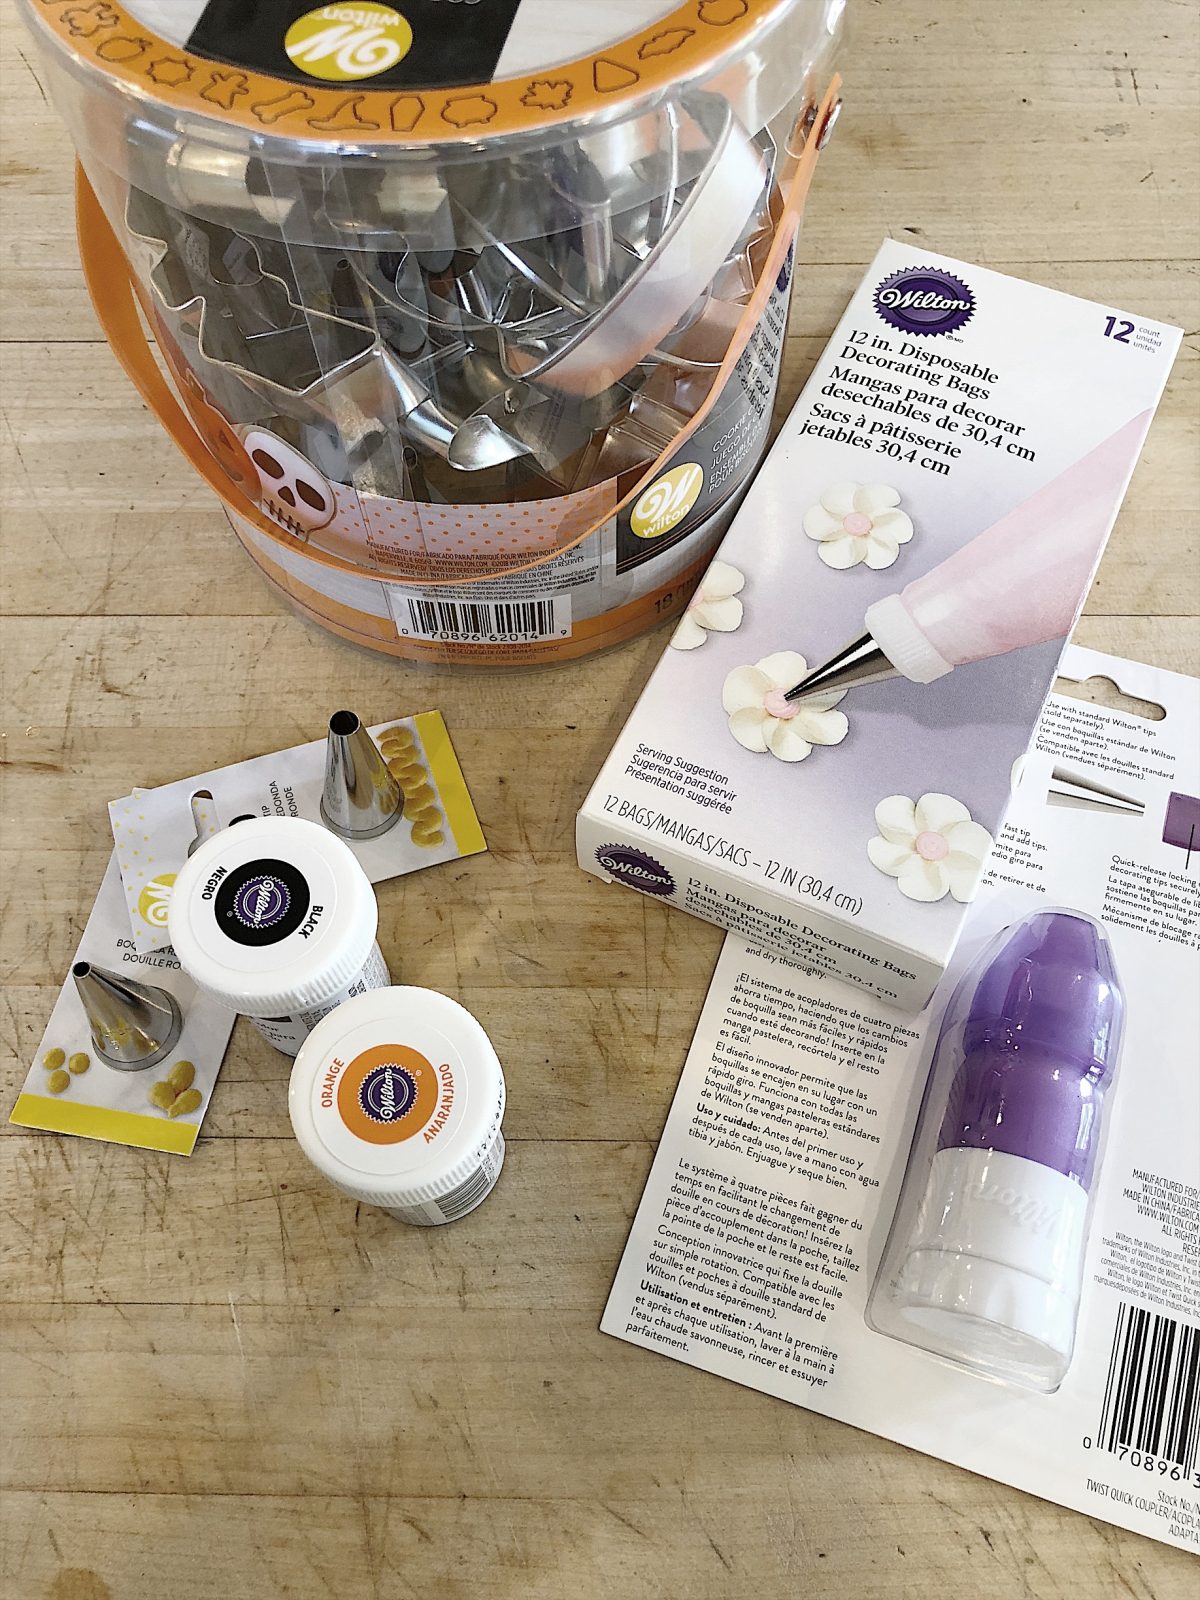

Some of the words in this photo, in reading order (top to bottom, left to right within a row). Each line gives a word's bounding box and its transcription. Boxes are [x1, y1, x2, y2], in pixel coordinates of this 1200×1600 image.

[322, 8, 400, 27] wilton
[879, 288, 971, 310] Wilton
[1104, 316, 1135, 344] 12
[1136, 334, 1162, 347] unidad
[1138, 327, 1160, 338] count
[840, 346, 944, 387] Decorating
[946, 375, 990, 400] Bags
[850, 330, 869, 345] 12
[870, 335, 893, 352] in.
[898, 342, 999, 384] Disposable
[829, 365, 902, 395] Mangas
[903, 388, 948, 410] para
[952, 404, 1026, 437] decorar
[712, 415, 746, 452] COOKIE
[810, 402, 852, 424] Sacs
[854, 414, 866, 428] à
[867, 421, 962, 458] pâtisserie
[822, 384, 930, 423] desechables
[935, 417, 957, 432] de
[962, 427, 1003, 448] 30,4
[1006, 443, 1036, 462] cm
[711, 435, 741, 470] JUEGO
[798, 420, 873, 450] jetables
[875, 442, 917, 463] 30,4
[920, 457, 951, 476] cm
[642, 504, 690, 536] wilton
[430, 630, 480, 642] 70896
[489, 632, 538, 642] 62014
[1061, 706, 1077, 714] with
[1078, 711, 1111, 724] standard
[1143, 728, 1157, 737] tips
[1040, 718, 1056, 728] Use
[1072, 726, 1104, 741] boquillas
[1105, 737, 1138, 750] estándar
[1139, 745, 1149, 754] de
[1150, 747, 1176, 761] Wilton
[630, 754, 684, 782] Sugerencia
[683, 776, 707, 791] para
[707, 785, 738, 802] servir
[636, 743, 674, 765] Serving
[673, 756, 729, 786] Suggestion
[284, 786, 299, 817] RONDE
[625, 765, 685, 796] Présentation
[685, 790, 732, 815] suggérée
[1000, 833, 1015, 841] and
[1016, 836, 1031, 846] add
[1032, 841, 1048, 851] tips.
[1004, 822, 1018, 834] fast
[1020, 828, 1031, 838] tip
[600, 856, 672, 885] Wilton
[603, 795, 619, 813] 12
[617, 801, 752, 867] BAGS/MANGAS/SACS
[764, 860, 780, 880] 12
[779, 866, 798, 887] IN
[798, 875, 834, 902] (30,4
[834, 893, 863, 916] cm)
[1111, 855, 1167, 877] Quick-release
[1168, 871, 1197, 889] locking
[202, 866, 228, 900] NEGRO
[1110, 864, 1152, 884] decorating
[1154, 877, 1168, 887] tips
[253, 880, 274, 924] Wilton
[298, 905, 324, 939] BLACK
[686, 888, 737, 915] Mangas
[740, 912, 770, 929] para
[774, 926, 827, 952] decorar
[688, 878, 701, 889] 12
[704, 884, 721, 897] in.
[725, 893, 799, 930] Disposable
[801, 926, 880, 966] Decorating
[882, 960, 917, 980] Bags
[123, 953, 165, 968] DOUILLE
[745, 947, 762, 957] and
[762, 951, 778, 964] dry
[779, 956, 829, 980] thoroughly.
[816, 953, 838, 965] cm
[736, 973, 750, 989] ¡El
[750, 979, 783, 996] sistema
[784, 988, 796, 999] de
[796, 994, 848, 1016] acopladores
[849, 1009, 861, 1020] de
[862, 1016, 892, 1030] cuatro
[891, 1024, 920, 1039] piezas
[723, 1018, 752, 1034] manga
[752, 1028, 795, 1049] pastelera,
[797, 1043, 837, 1061] recórtela
[838, 1057, 845, 1066] y
[846, 1058, 856, 1067] el
[856, 1062, 880, 1075] resto
[321, 1058, 344, 1108] ORANGE
[380, 1068, 396, 1119] Wilton
[422, 1063, 455, 1144] ANARANJADO
[704, 1076, 742, 1096] boquillas
[742, 1092, 750, 1101] y
[751, 1094, 785, 1112] mangas
[785, 1106, 831, 1127] pasteleras
[832, 1122, 880, 1144] estándares
[697, 1103, 714, 1116] Uso
[713, 1112, 722, 1121] y
[722, 1115, 761, 1133] cuidado:
[762, 1126, 790, 1143] Antes
[791, 1136, 807, 1148] del
[806, 1144, 838, 1159] primer
[839, 1155, 856, 1165] uso
[856, 1161, 864, 1169] y
[1123, 1188, 1142, 1202] MADE
[1143, 1195, 1150, 1205] IN
[1132, 1168, 1184, 1193] MANUFACTURED
[1142, 1183, 1167, 1199] WILTON
[1137, 1204, 1199, 1233] WWW.WILTON.COM
[1161, 1224, 1172, 1237] ALL
[1174, 1228, 1198, 1244] RIGHTS
[658, 1224, 711, 1252] Conception
[712, 1243, 764, 1271] innovatrice
[765, 1266, 782, 1277] qui
[782, 1268, 800, 1284] fixe
[801, 1275, 810, 1287] la
[811, 1280, 843, 1299] douille
[646, 1263, 676, 1283] Wilton
[678, 1274, 715, 1297] (vendus
[715, 1290, 777, 1320] séparément).
[625, 1323, 689, 1352] parfaitement.
[1083, 1436, 1091, 1449] 0
[1119, 1446, 1180, 1481] 70896
[1086, 1478, 1109, 1496] TWIST
[1111, 1488, 1134, 1506] QUICK
[1157, 1490, 1178, 1507] Stock
